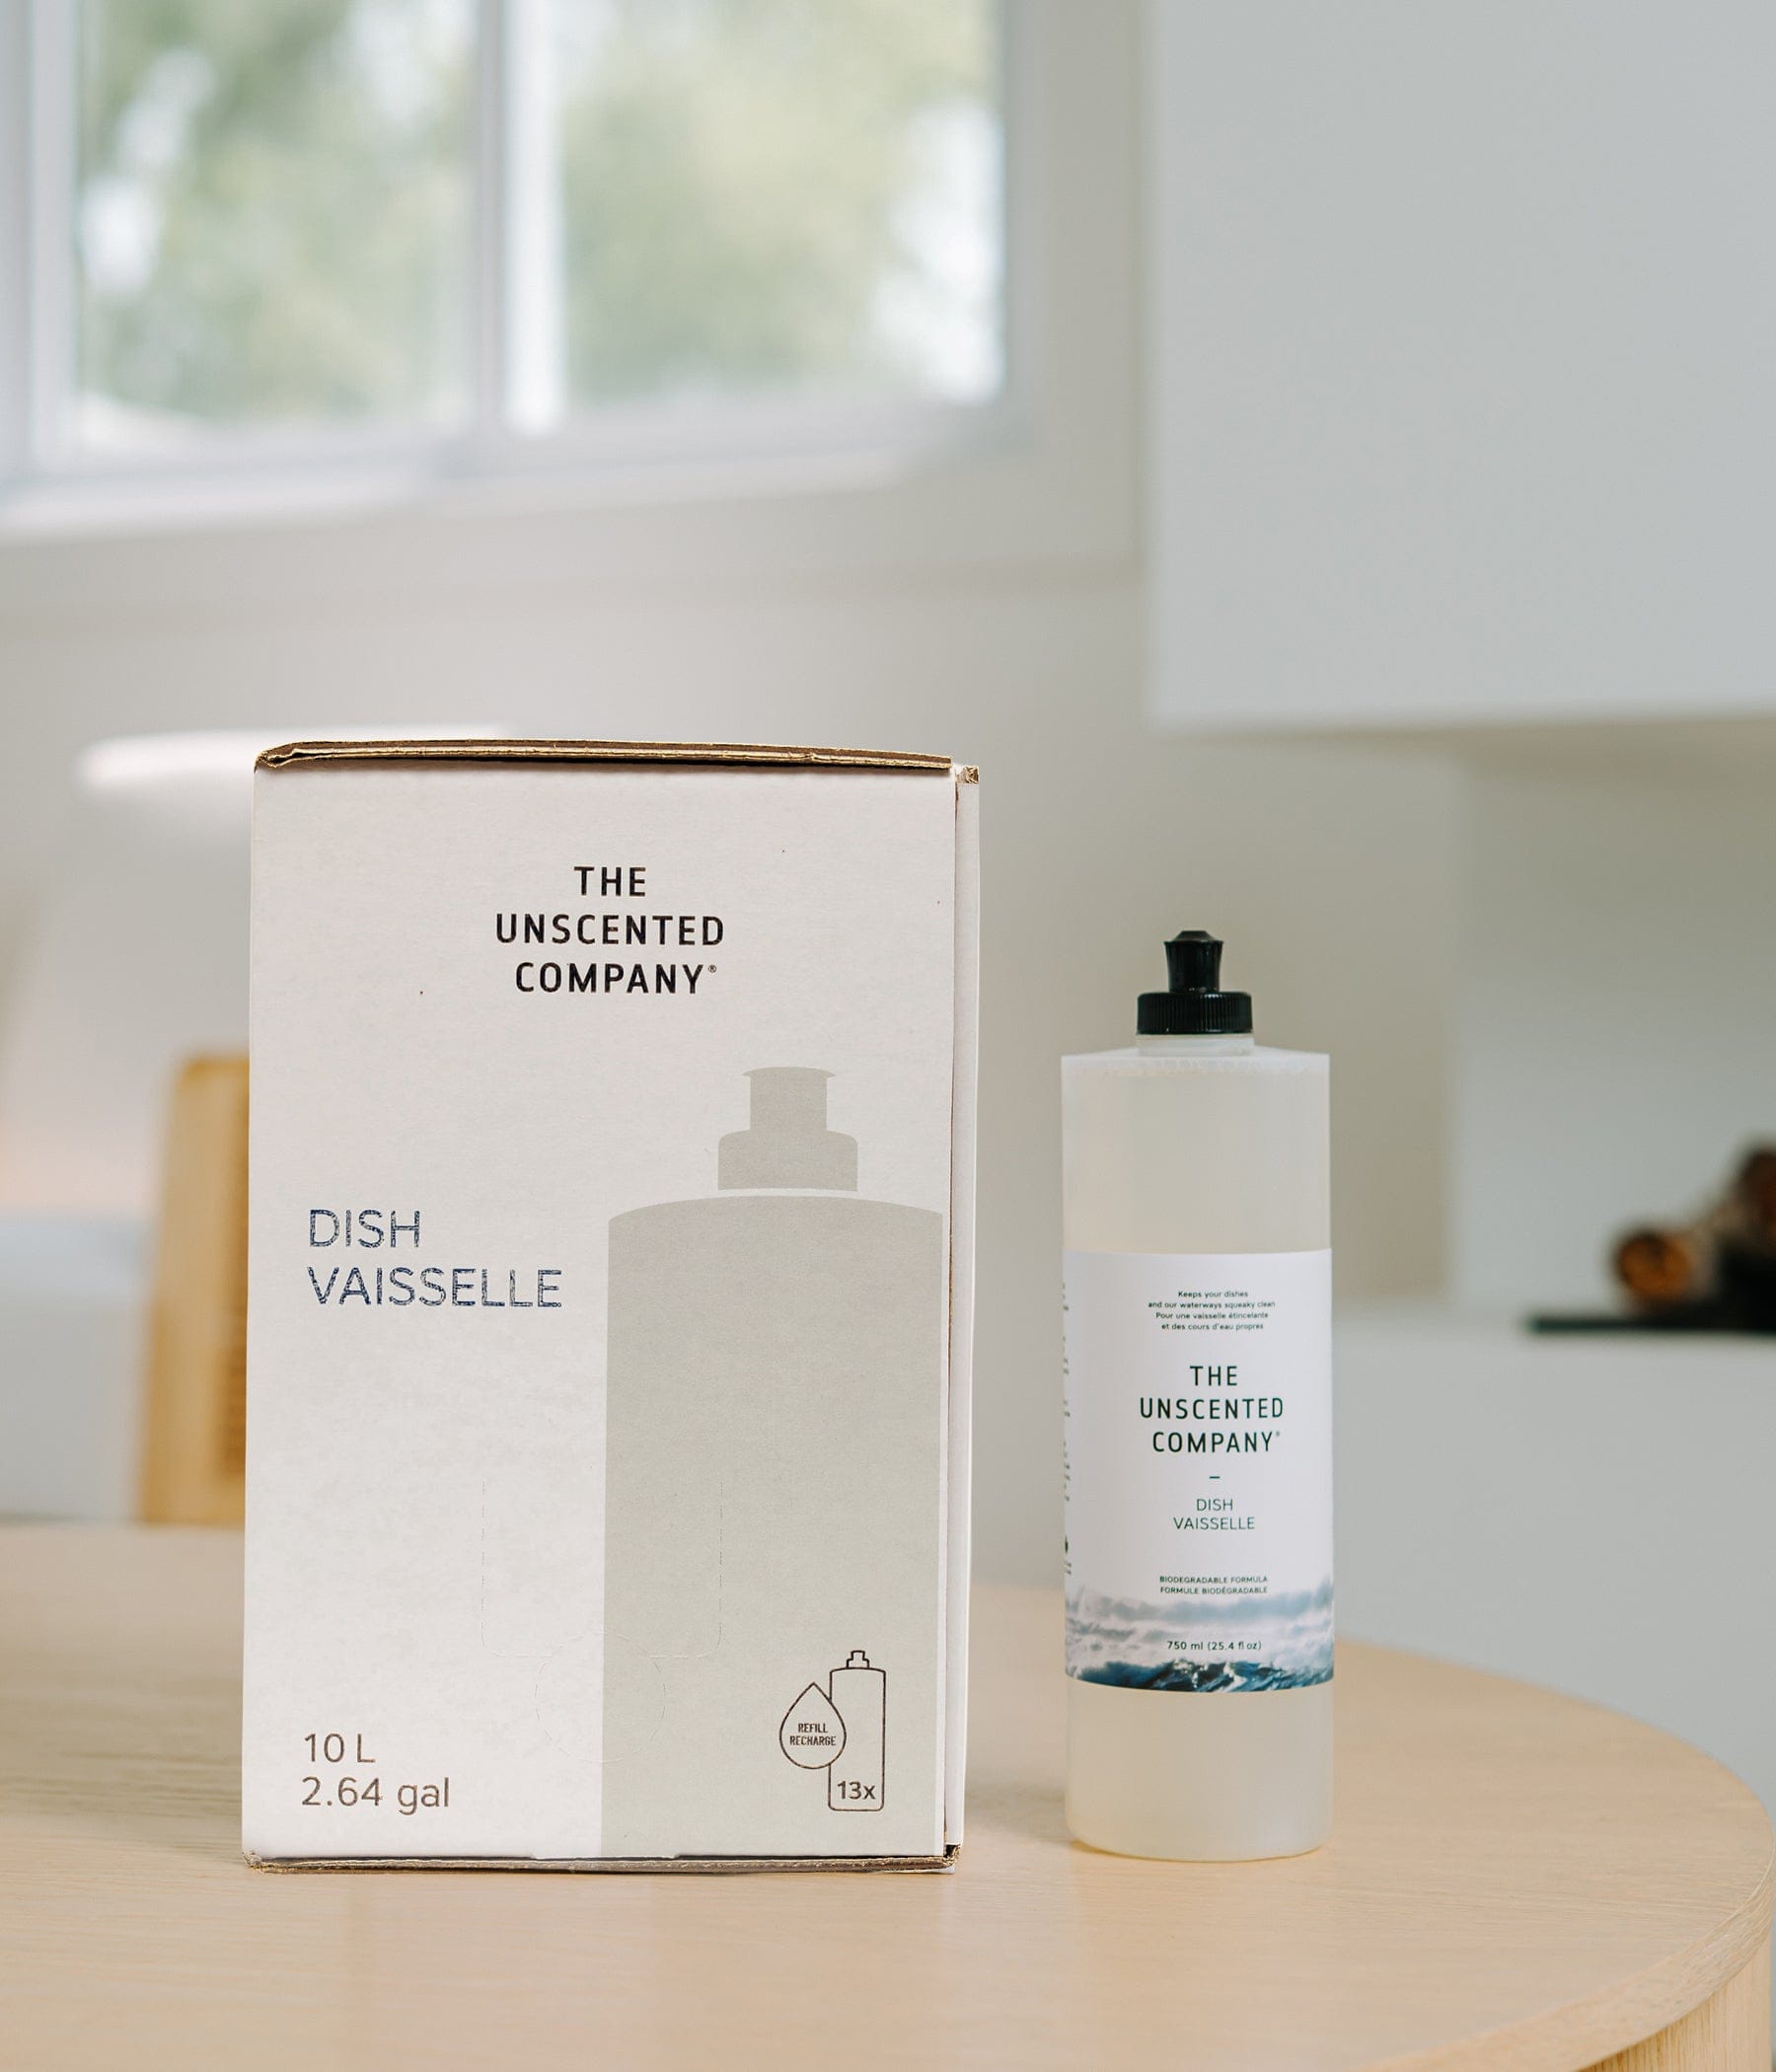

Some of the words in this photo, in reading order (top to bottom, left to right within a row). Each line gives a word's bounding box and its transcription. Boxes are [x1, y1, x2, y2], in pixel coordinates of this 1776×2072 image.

[574, 866, 645, 897] THE
[496, 914, 723, 945] UNSCENTED
[310, 1210, 420, 1248] DISH
[307, 1267, 561, 1307] VAISSELLE
[1177, 1291, 1203, 1299] Keeps
[1223, 1290, 1249, 1298] dishes
[1179, 1301, 1222, 1310] waterways
[1223, 1300, 1256, 1310] squeaky
[1155, 1311, 1174, 1320] Pour
[1192, 1311, 1226, 1320] vaisselle
[1227, 1311, 1269, 1320] étincelante
[1171, 1322, 1186, 1331] des
[1235, 1323, 1264, 1332] propres
[1190, 1366, 1237, 1386] THE
[1141, 1397, 1283, 1419] UNSCENTED
[1197, 1499, 1232, 1511] DISH
[1173, 1517, 1254, 1530] VAISSELLE
[1158, 1575, 1227, 1585] BIODEGRADABLE
[1229, 1575, 1268, 1585] FORMULA
[1159, 1586, 1199, 1594] FORMULE
[1201, 1586, 1268, 1595] BIODÉGRADABLE
[1166, 1640, 1188, 1651] 750
[1190, 1641, 1204, 1651] ml
[1207, 1641, 1234, 1652] (25.4
[1246, 1640, 1262, 1651] oz)
[797, 1722, 829, 1734] REFILL
[789, 1735, 837, 1746] RECHARGE
[305, 1734, 344, 1762] 10
[357, 1734, 375, 1763] L
[302, 1777, 383, 1807] 2.64
[398, 1777, 449, 1815] gal
[838, 1781, 875, 1800] 13x
